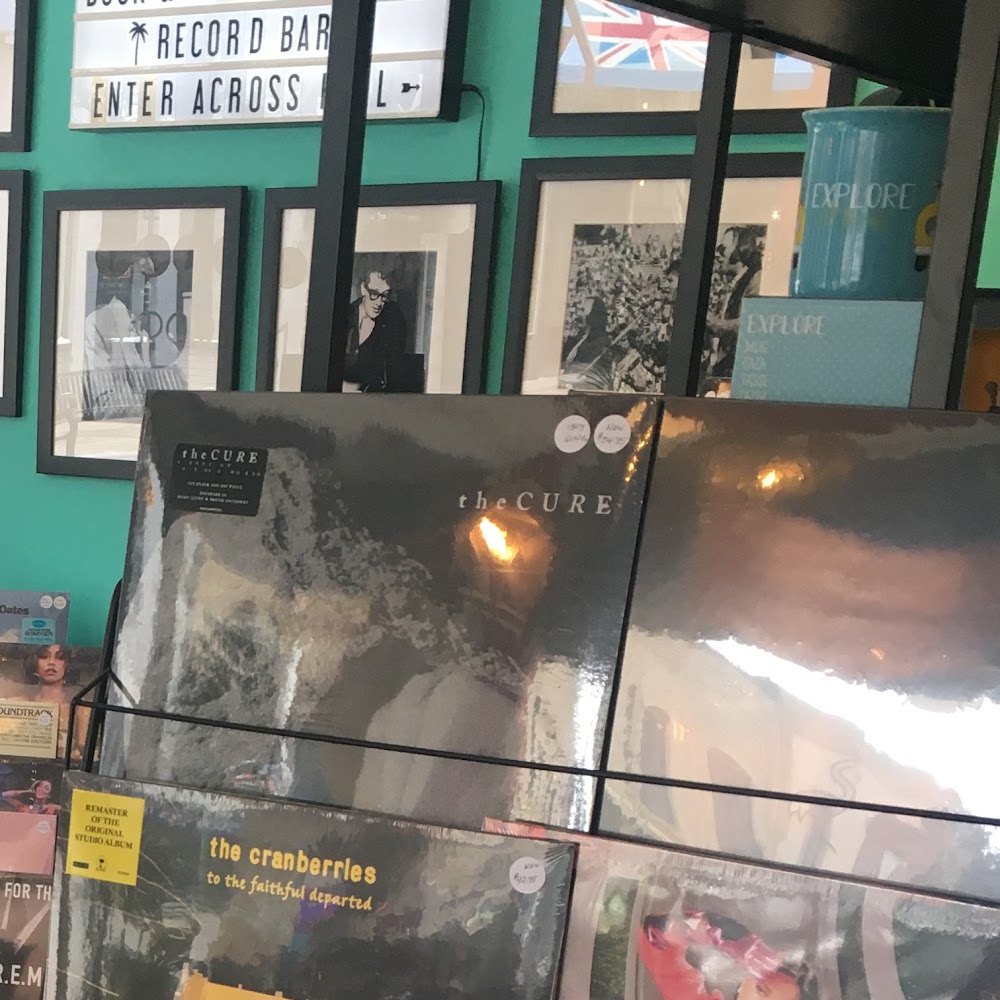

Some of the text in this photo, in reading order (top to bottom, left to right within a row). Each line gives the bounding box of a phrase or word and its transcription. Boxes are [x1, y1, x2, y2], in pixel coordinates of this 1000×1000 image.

[157, 13, 330, 60] RECORD BAR
[93, 80, 175, 119] ENTER
[192, 73, 300, 116] ACROSS
[810, 182, 915, 210] EXPLORE
[747, 314, 828, 335] EXPLORE
[0, 604, 29, 616] Oates
[85, 804, 128, 817] REMASTER
[91, 815, 120, 827] OF THE
[85, 825, 124, 838] ORIGINAL
[74, 834, 133, 850] STUDIO ALBUM
[210, 837, 377, 885] the cranberries
[4, 883, 31, 899] FOR
[36, 884, 52, 901] TH
[207, 871, 373, 911] to the faithful departed
